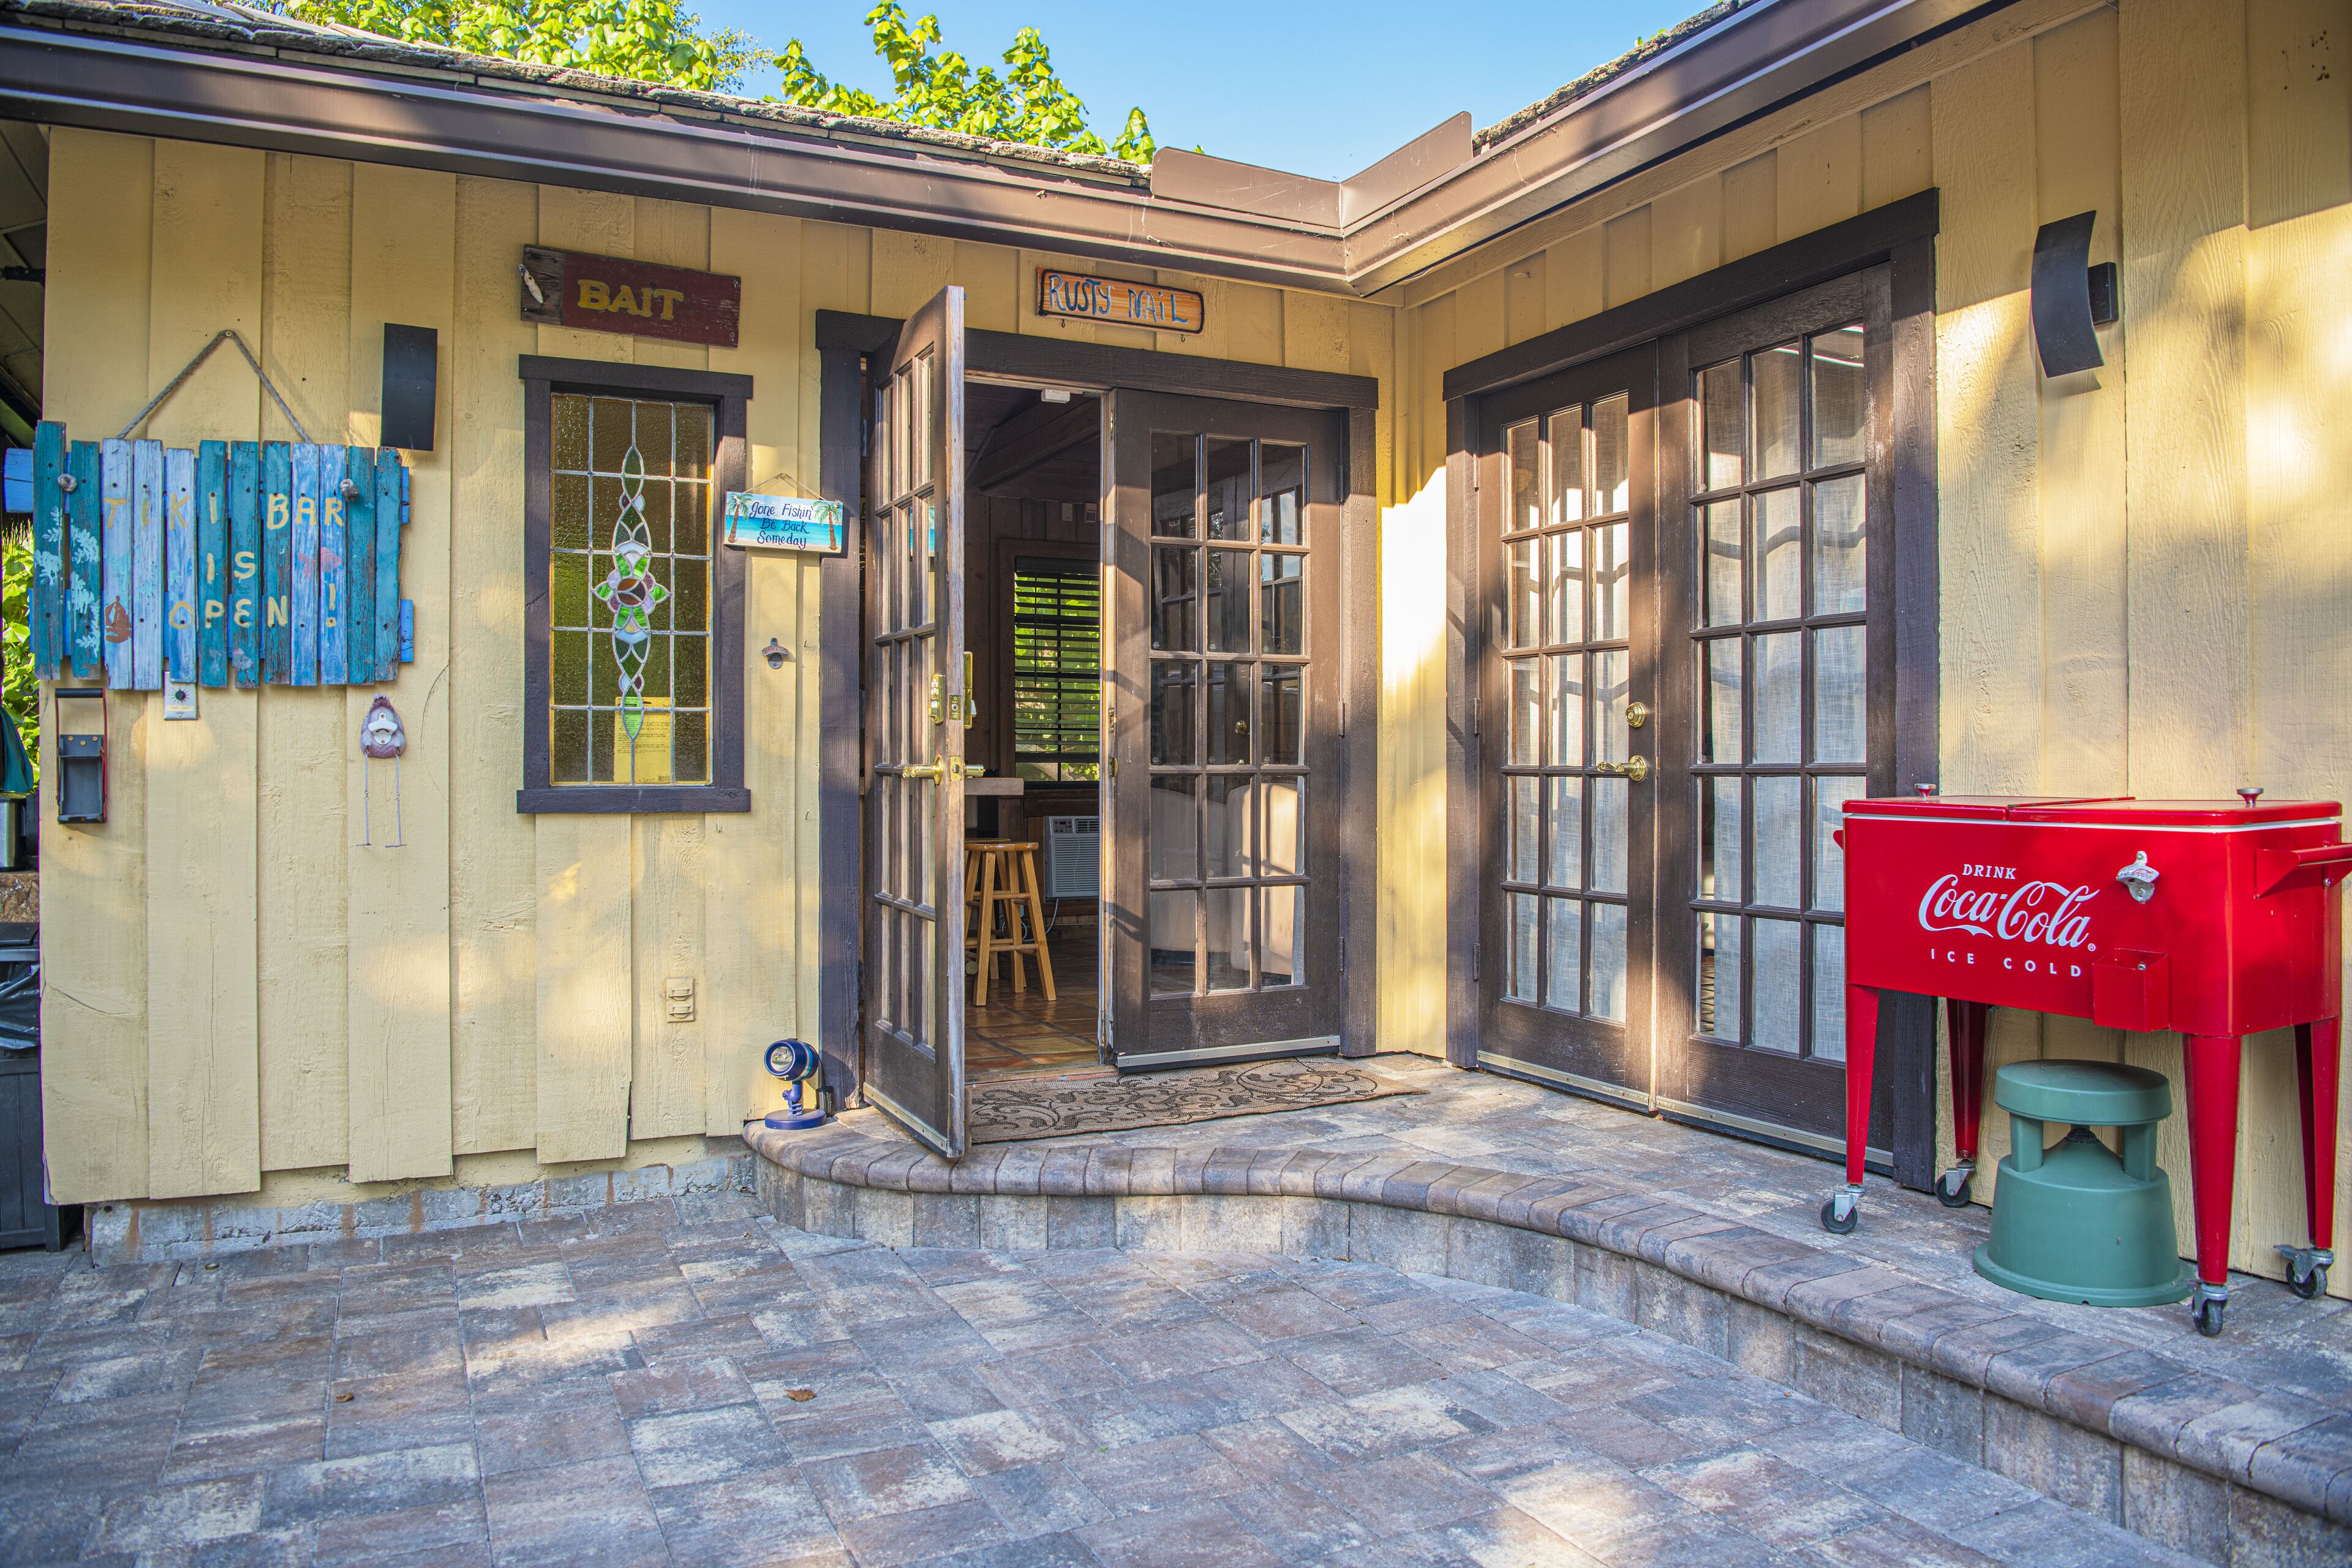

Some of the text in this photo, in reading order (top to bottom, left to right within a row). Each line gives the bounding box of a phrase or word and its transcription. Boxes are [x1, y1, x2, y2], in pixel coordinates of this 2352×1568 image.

[577, 279, 684, 320] BAIT
[1048, 274, 1112, 316] RUSTY
[103, 492, 344, 530] TIKI BAR
[760, 518, 810, 534] Be Back
[756, 530, 807, 550] Someday
[206, 551, 256, 585] IS
[1962, 864, 2017, 880] DRINK
[1918, 874, 2100, 948] Coca-Cola
[1931, 949, 2082, 978] ICE COLD
